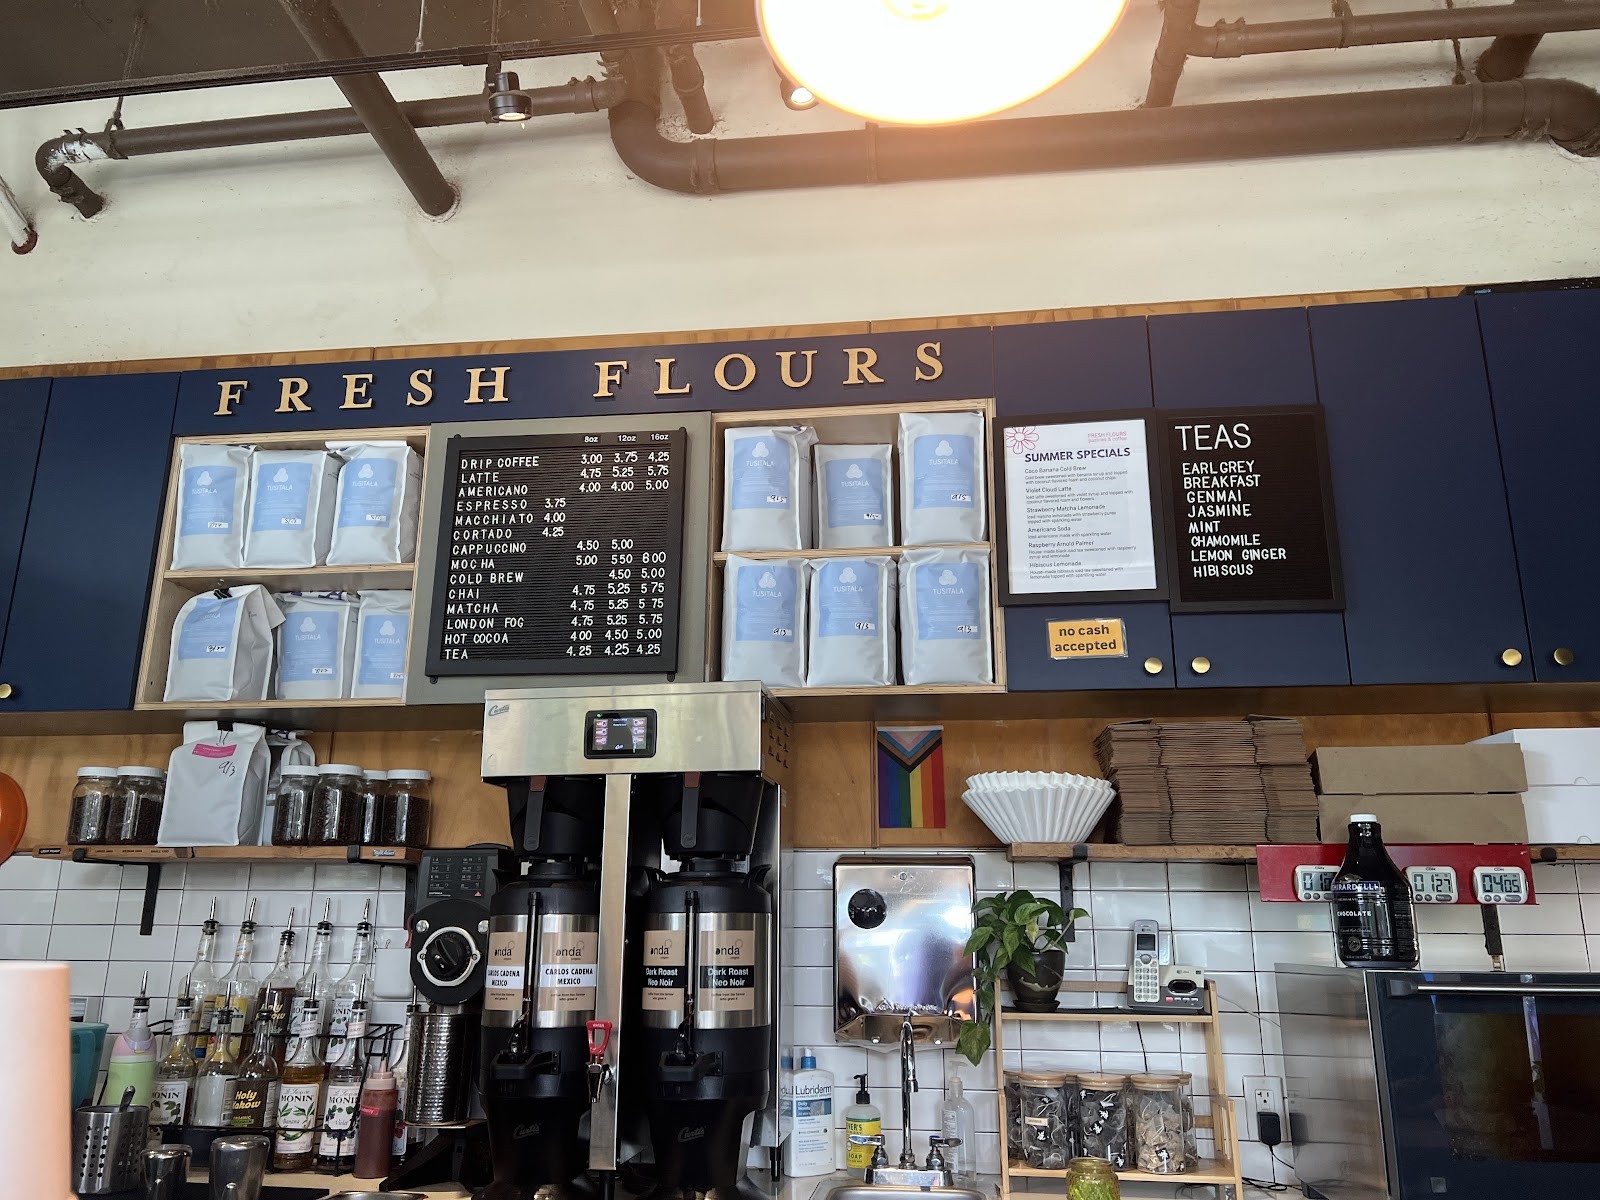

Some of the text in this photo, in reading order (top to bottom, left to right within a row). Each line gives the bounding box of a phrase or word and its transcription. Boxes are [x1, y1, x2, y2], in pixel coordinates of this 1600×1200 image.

[213, 342, 944, 416] FRESH FLOURS
[1174, 423, 1251, 451] TEAS
[461, 451, 669, 469] DRIP COFFEE 3.00 3.75 4.25
[1025, 448, 1130, 462] SUMMER SPECIALS
[461, 465, 668, 483] LATTE 4.75 5.25 5.75
[1182, 460, 1255, 475] EARL GREY
[1184, 474, 1261, 489] BREAKFAST
[458, 480, 668, 498] AMERICANO 4.00 4.00 5.00
[1187, 490, 1242, 503] GENMAI
[457, 498, 566, 511] ESPRESSO 3.75
[1188, 504, 1251, 517] JASMINE
[455, 512, 565, 526] MACCHIATO 4.00
[453, 527, 564, 540] CORTADO 4.25
[1188, 521, 1220, 533] MINT
[452, 539, 633, 555] CAPPUCCINO 4.50 5.00
[1191, 534, 1261, 547] CHAMOMILE
[451, 559, 494, 569] MOCHA
[576, 555, 597, 565] 5.00
[1191, 548, 1286, 562] LEMON GINGER
[450, 568, 665, 584] COLD BREW 4.50 5.00
[1194, 564, 1254, 577] HIBISCUS
[449, 588, 480, 599] CHAI
[572, 585, 595, 595] 4.75
[608, 583, 630, 594] 5.25
[447, 602, 499, 614] MATCHA
[570, 600, 594, 610] 4.75
[608, 599, 628, 609] 5.25
[447, 614, 662, 629] LONDON FOG 4.75 5.25 5.75
[445, 634, 466, 645] HOT
[473, 632, 509, 644] COCOA
[605, 629, 628, 640] 4.50
[637, 628, 662, 639] 5.00
[1059, 625, 1109, 636] no cash
[445, 643, 660, 659] TEA 4.25 4.25 4.25
[1055, 639, 1116, 653] accepted
[219, 761, 235, 776] 9/3
[556, 947, 582, 956] onda
[716, 946, 740, 955] onda
[646, 968, 657, 976] Dark
[659, 978, 673, 986] Noir
[730, 978, 745, 986] Noir
[236, 1090, 257, 1100] Holy
[796, 1084, 832, 1095] Lubriderm
[513, 1122, 540, 1139] Curtis
[678, 1126, 706, 1142] Curtis
